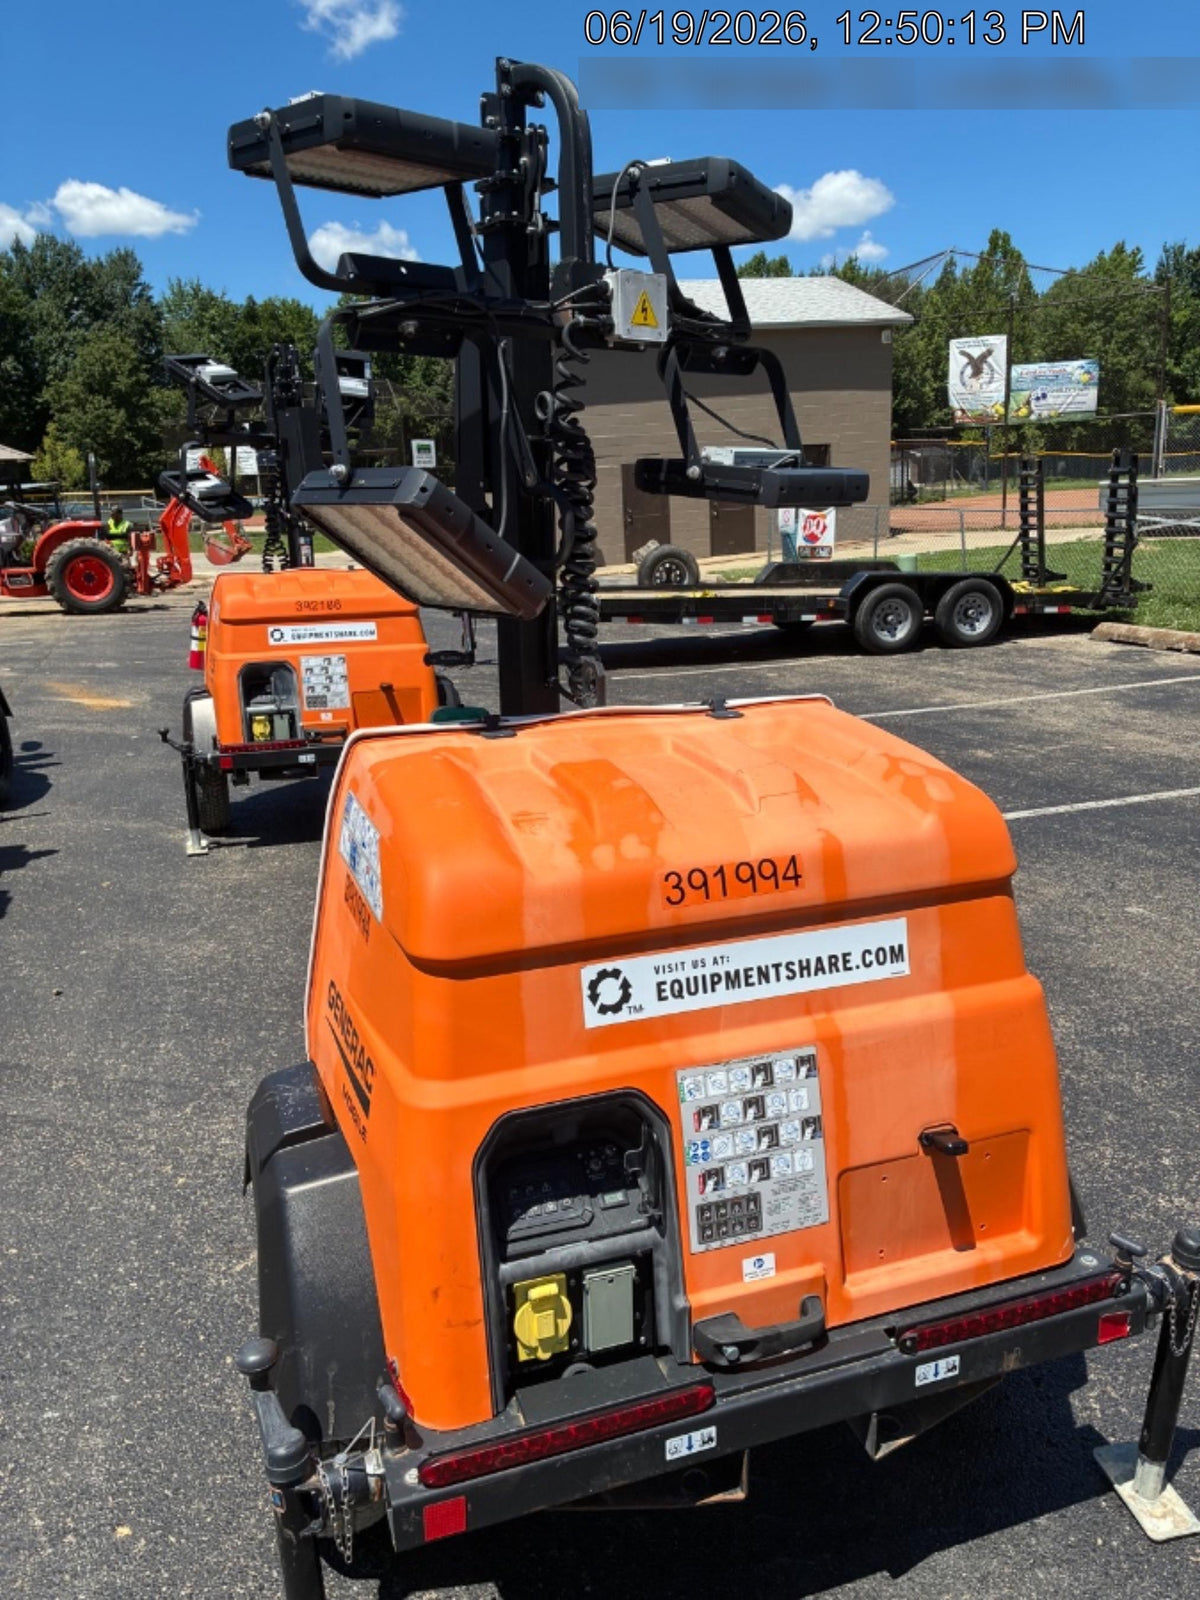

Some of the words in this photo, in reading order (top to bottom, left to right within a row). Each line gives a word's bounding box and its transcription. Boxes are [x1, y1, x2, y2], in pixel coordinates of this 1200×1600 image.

[663, 854, 802, 905] 391994
[653, 961, 686, 975] VISIT
[691, 958, 706, 969] US
[712, 955, 730, 966] AT:
[656, 943, 904, 1002] EQUIPMENTSHARE.COM
[328, 979, 375, 1094] GENERAC
